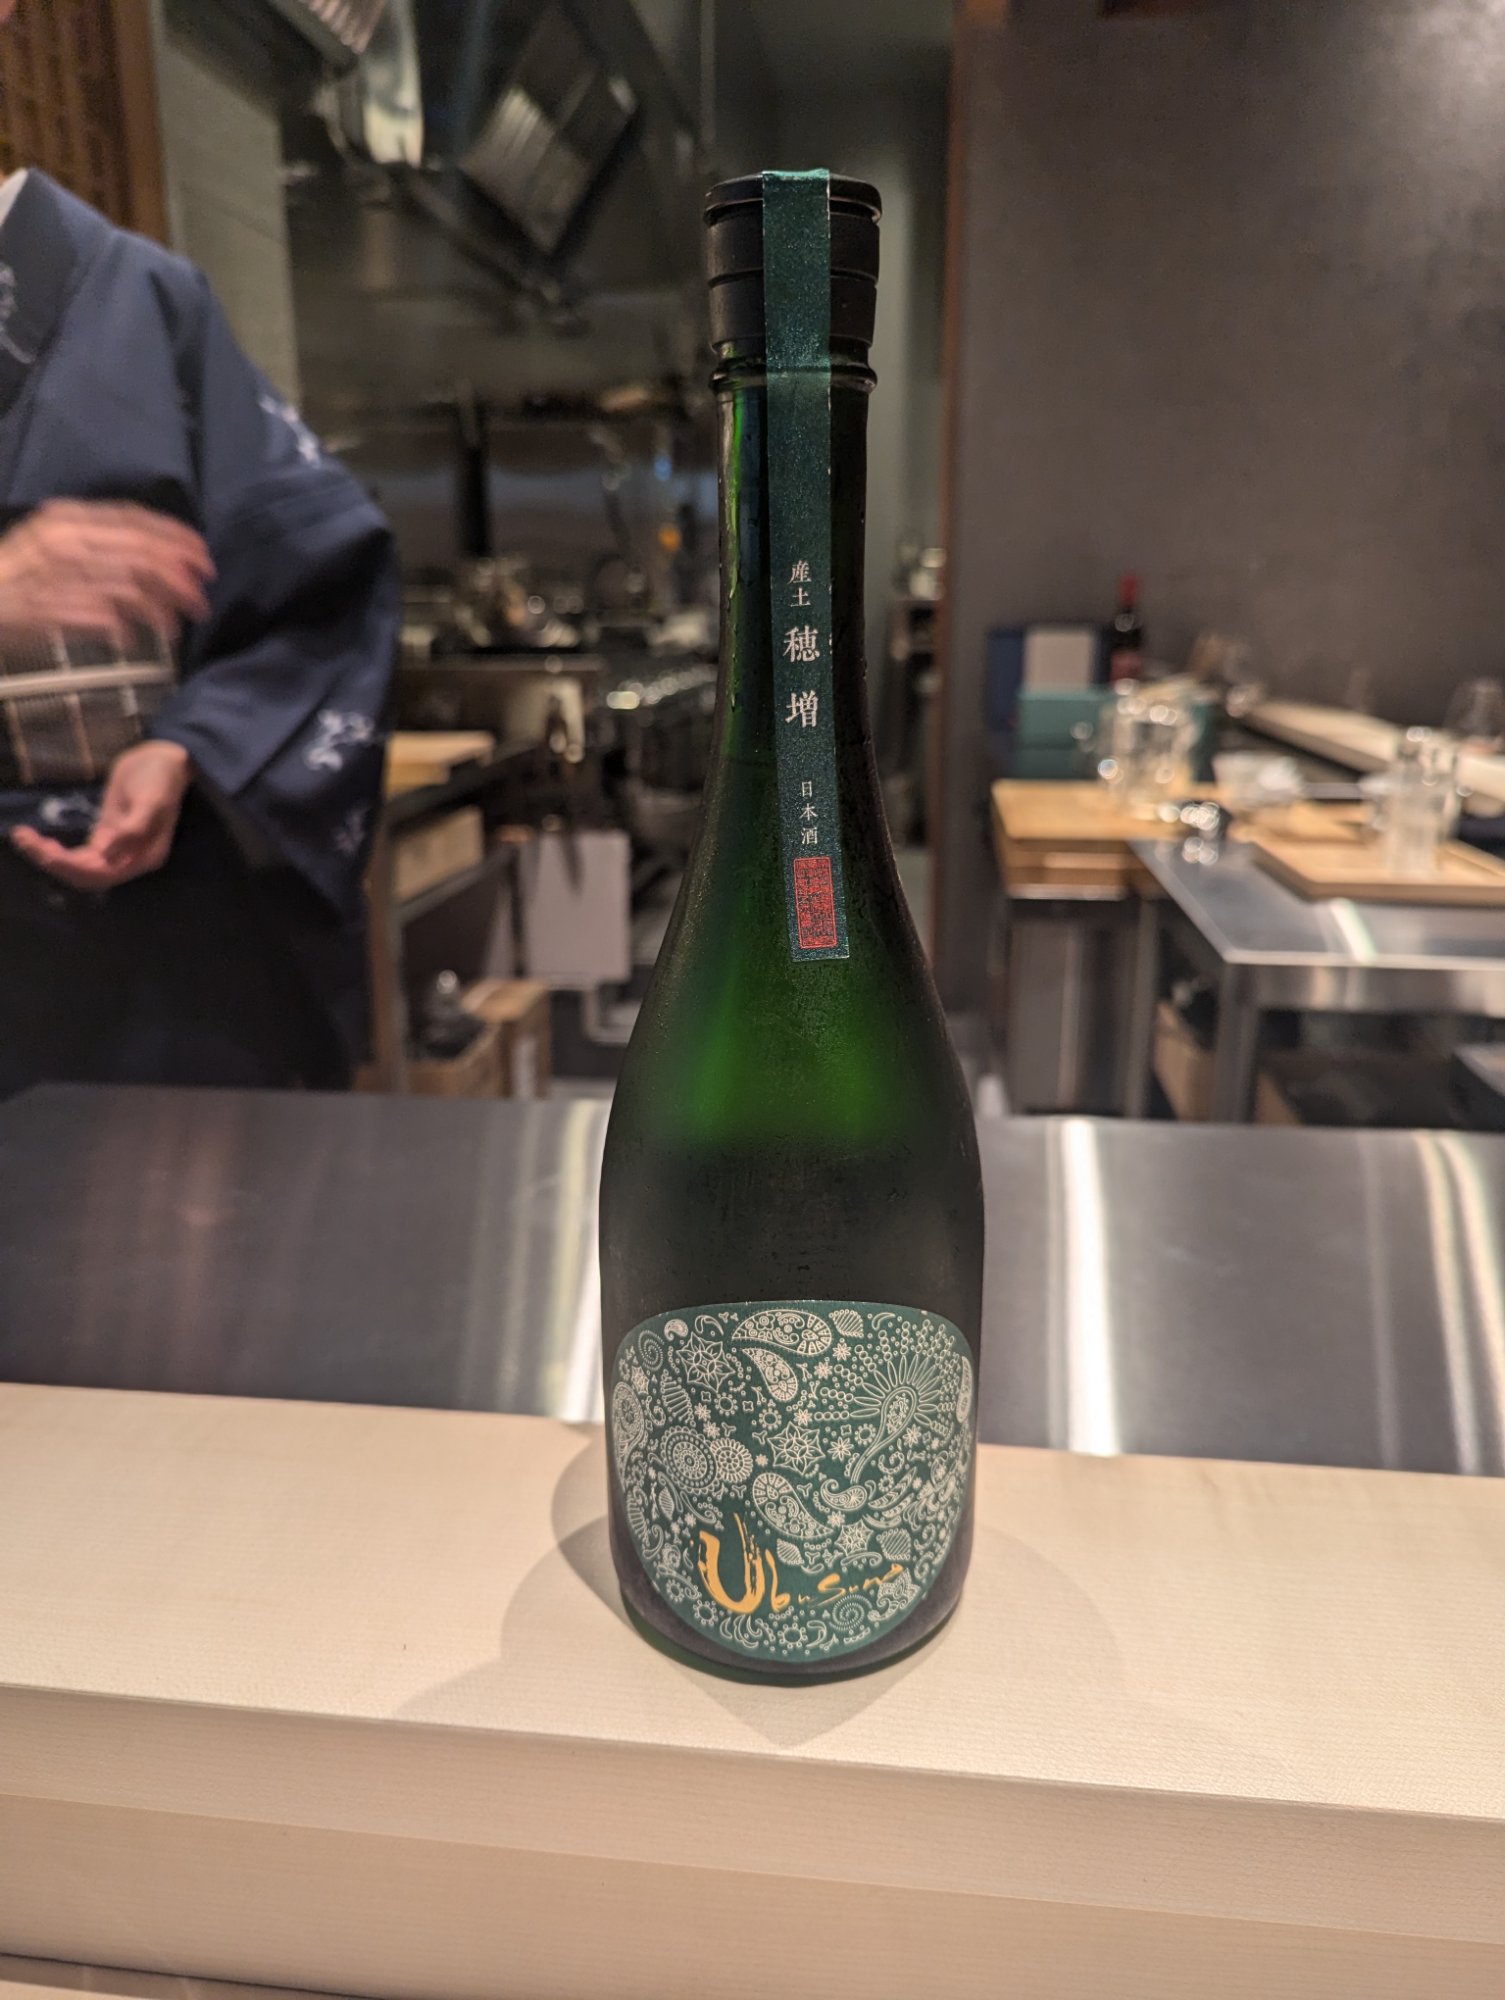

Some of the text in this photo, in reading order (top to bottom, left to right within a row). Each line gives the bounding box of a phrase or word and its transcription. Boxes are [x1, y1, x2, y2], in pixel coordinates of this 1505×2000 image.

[783, 560, 820, 728] 産土 穂増
[799, 780, 819, 845] 日本酒
